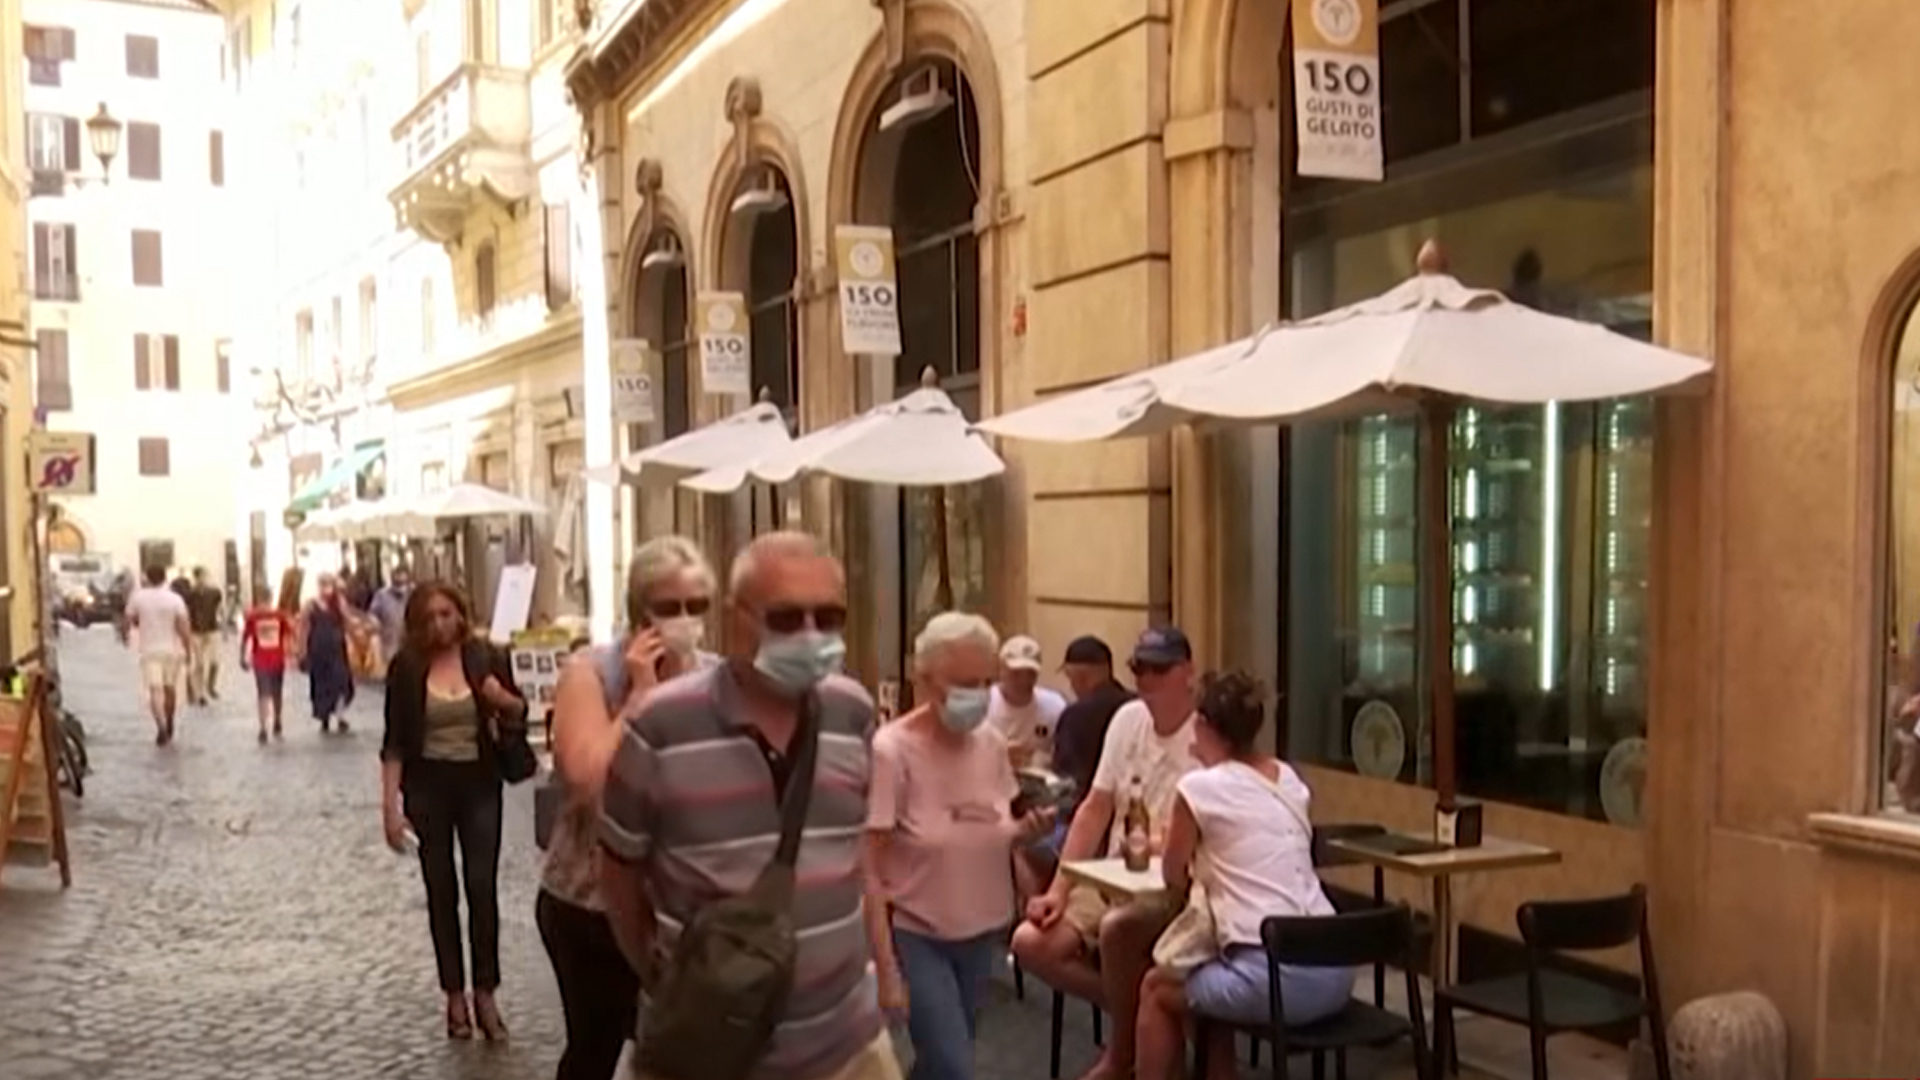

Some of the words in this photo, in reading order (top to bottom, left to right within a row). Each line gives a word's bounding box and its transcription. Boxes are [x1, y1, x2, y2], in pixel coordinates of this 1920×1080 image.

[1304, 60, 1371, 96] 150
[1306, 98, 1353, 117] GUSTI
[1357, 103, 1375, 119] DI
[1306, 117, 1376, 140] GELATO
[847, 286, 893, 306] 150
[705, 338, 743, 354] 150
